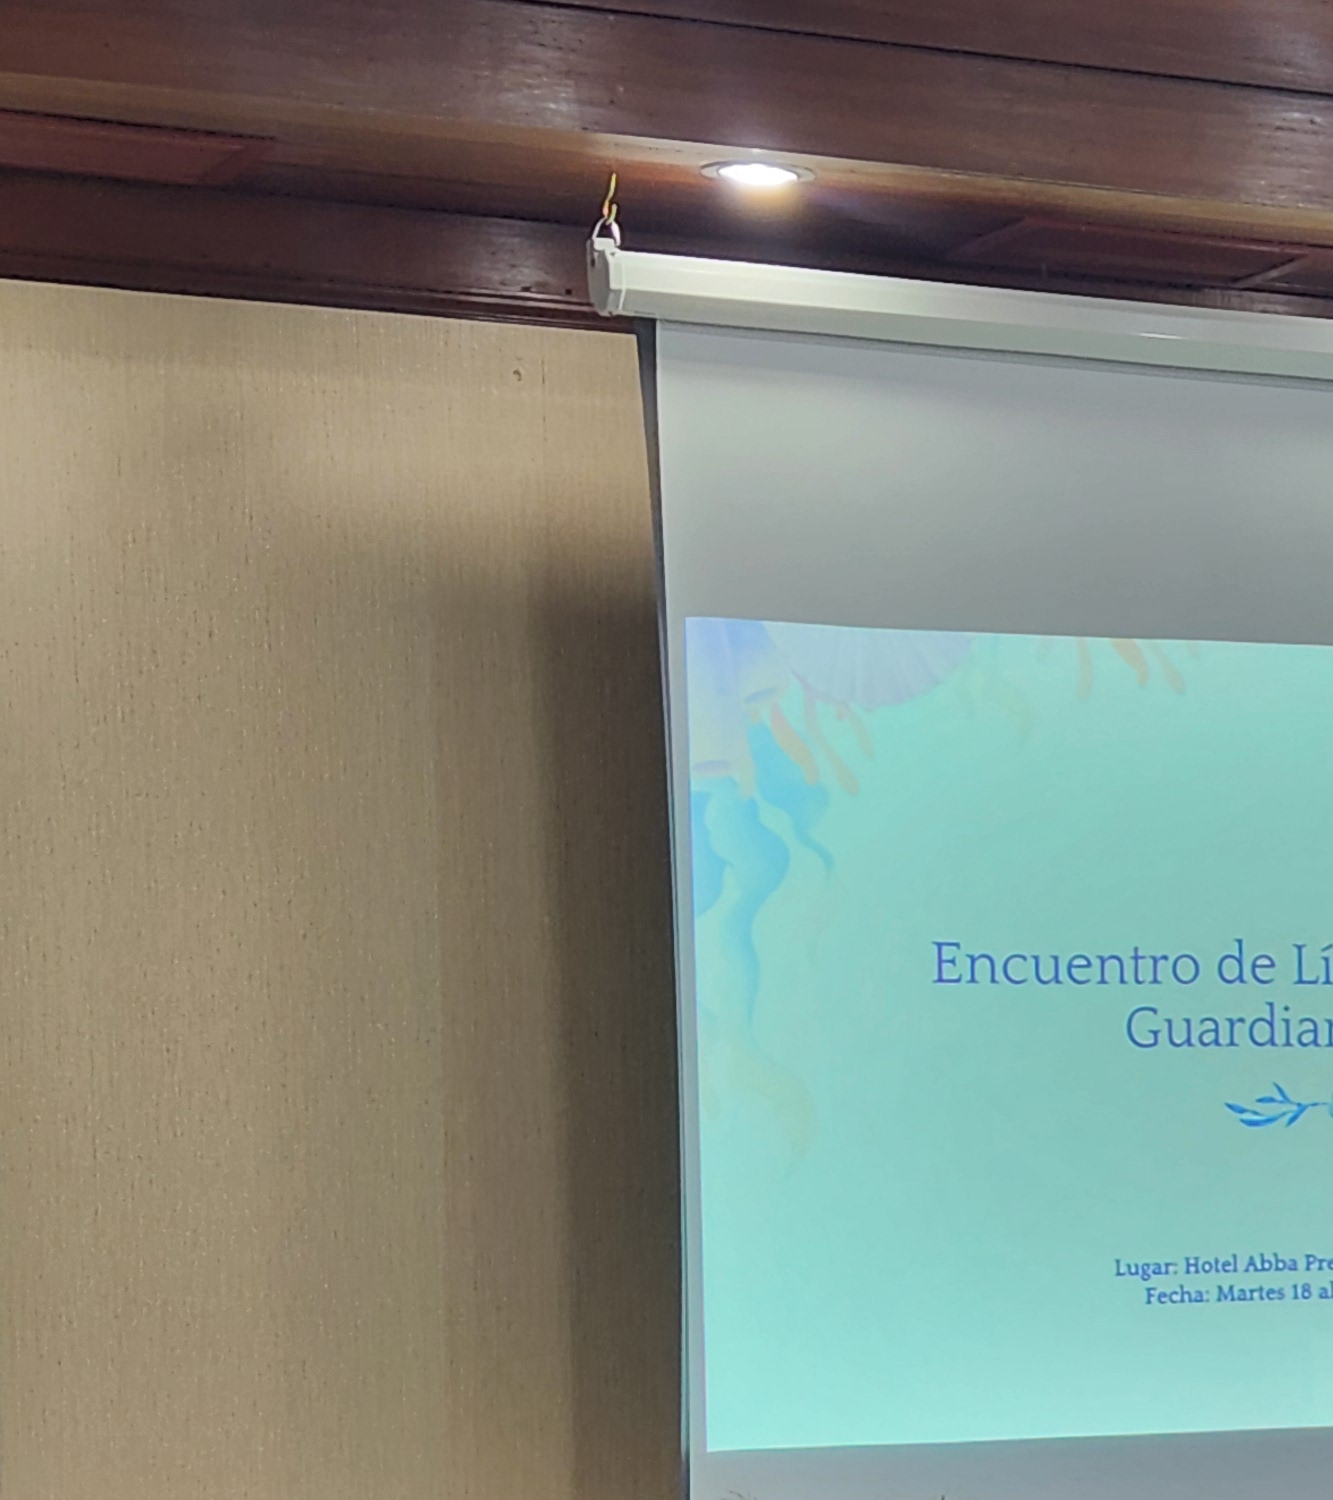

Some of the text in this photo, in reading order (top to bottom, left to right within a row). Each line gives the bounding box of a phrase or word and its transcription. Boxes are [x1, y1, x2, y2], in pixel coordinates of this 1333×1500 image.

[932, 940, 1200, 985] Encuentro
[1217, 938, 1276, 985] de
[1115, 1258, 1178, 1282] Lugar:
[1184, 1254, 1238, 1275] Hotel
[1243, 1253, 1298, 1273] Abba
[1145, 1284, 1210, 1305] Fecha:
[1216, 1282, 1286, 1302] Martes
[1292, 1283, 1312, 1300] 18
